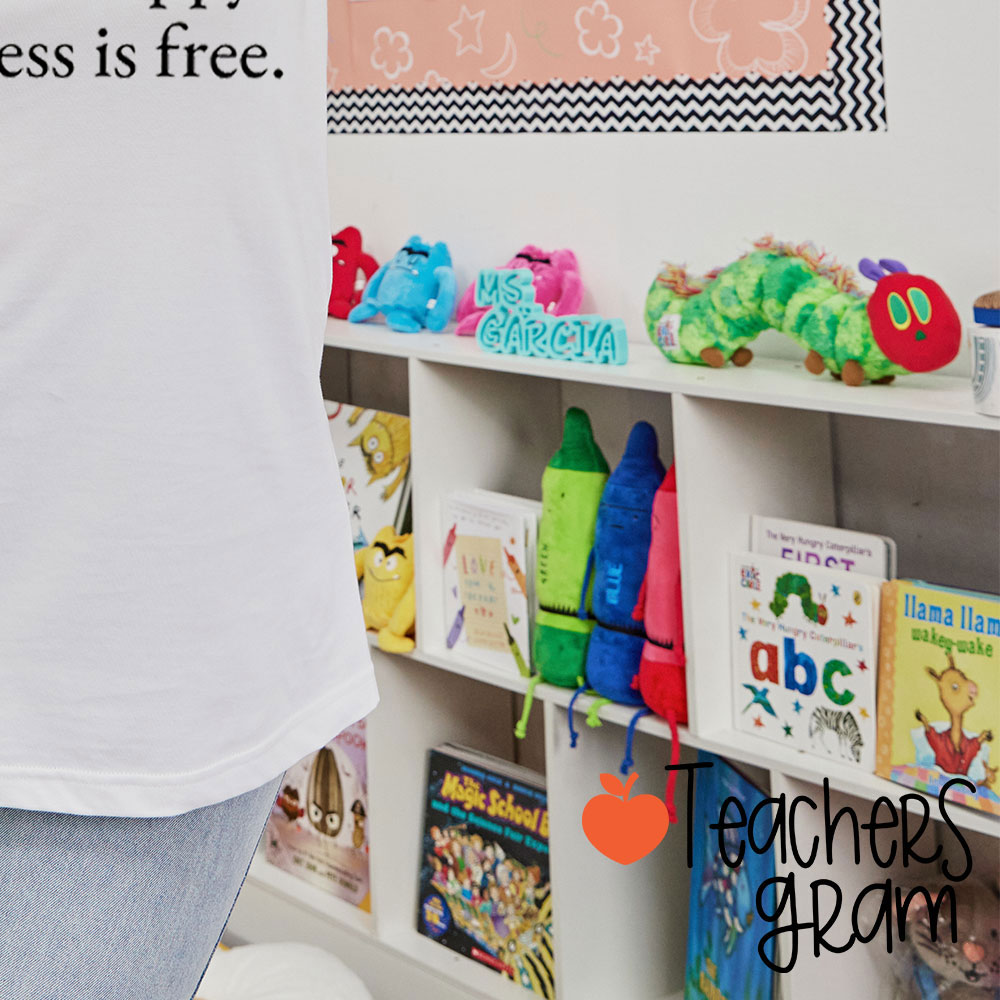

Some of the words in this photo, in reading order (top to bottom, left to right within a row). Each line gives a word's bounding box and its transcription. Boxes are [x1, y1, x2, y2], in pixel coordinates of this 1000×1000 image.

[96, 27, 136, 79] is
[157, 21, 284, 79] free.
[480, 312, 618, 364] GARCIA
[904, 593, 954, 628] llama
[961, 605, 1000, 638] llam
[750, 636, 855, 706] abc
[441, 771, 487, 811] Magic
[486, 788, 541, 832] School
